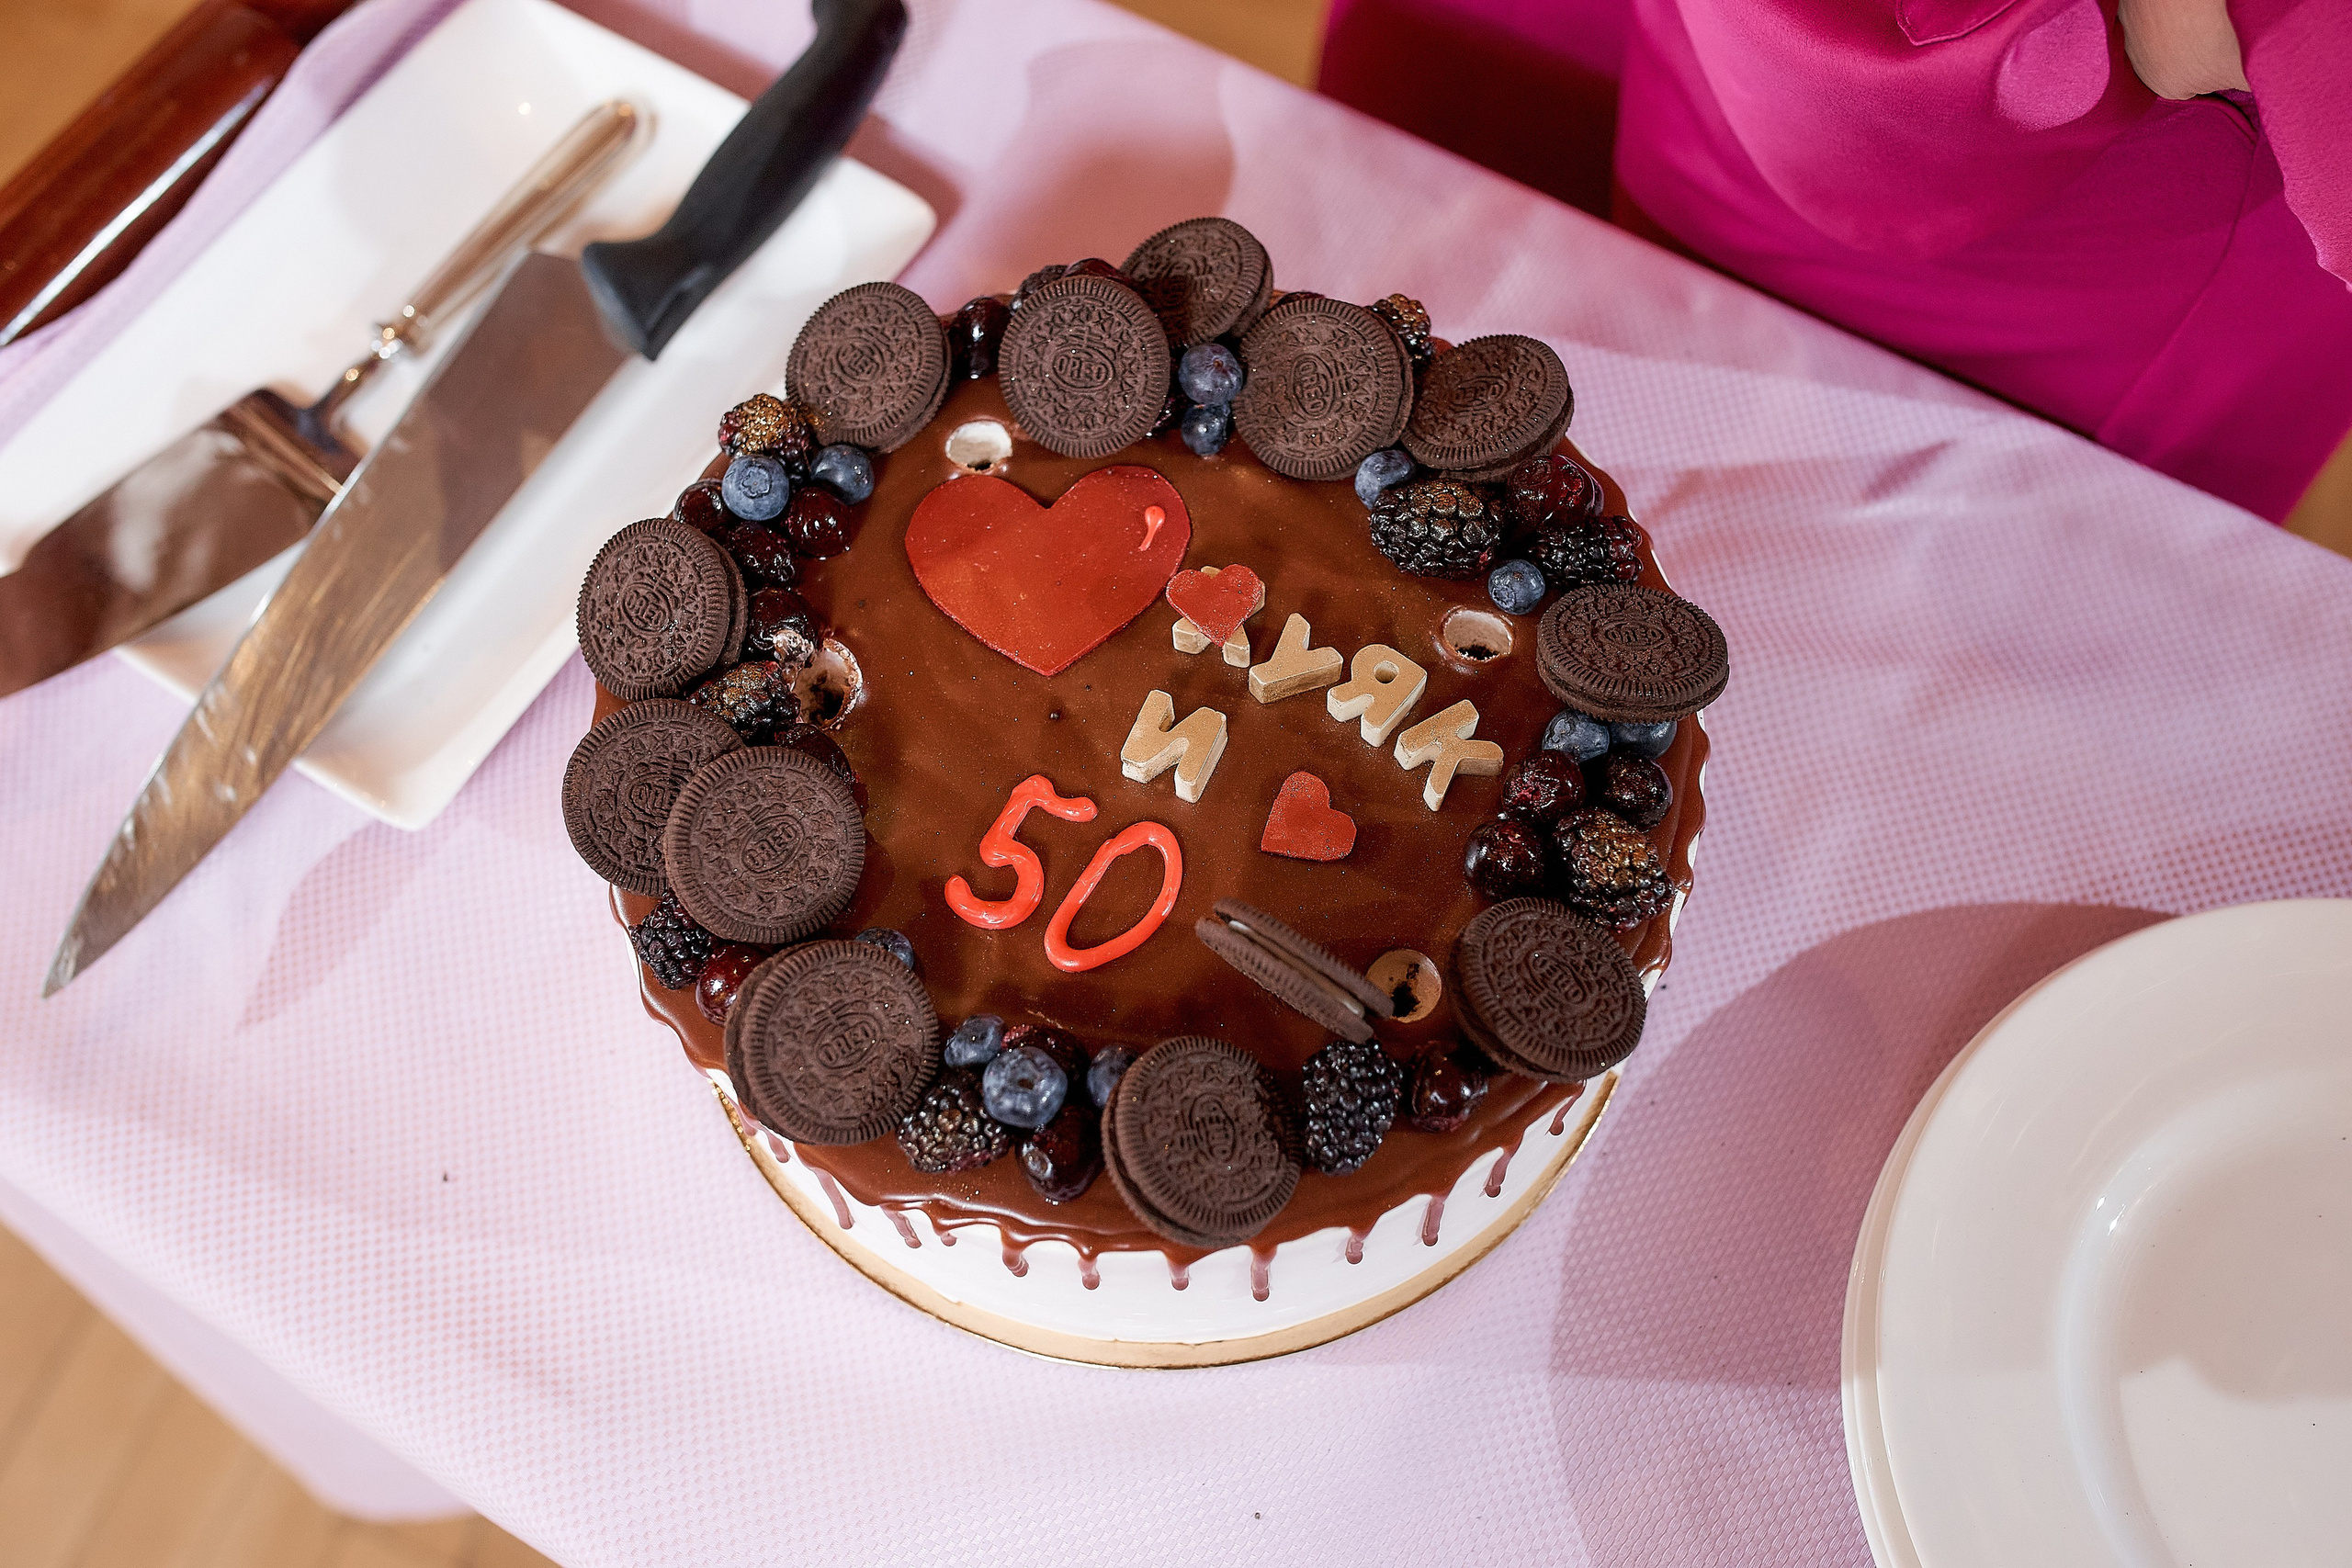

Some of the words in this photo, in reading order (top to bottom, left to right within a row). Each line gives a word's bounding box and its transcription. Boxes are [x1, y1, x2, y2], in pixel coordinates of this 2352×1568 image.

[1057, 354, 1110, 382] OREO
[1298, 359, 1329, 412] OREO
[1605, 627, 1666, 644] OREO
[944, 774, 1182, 973] 50
[820, 1021, 874, 1065] OREO
